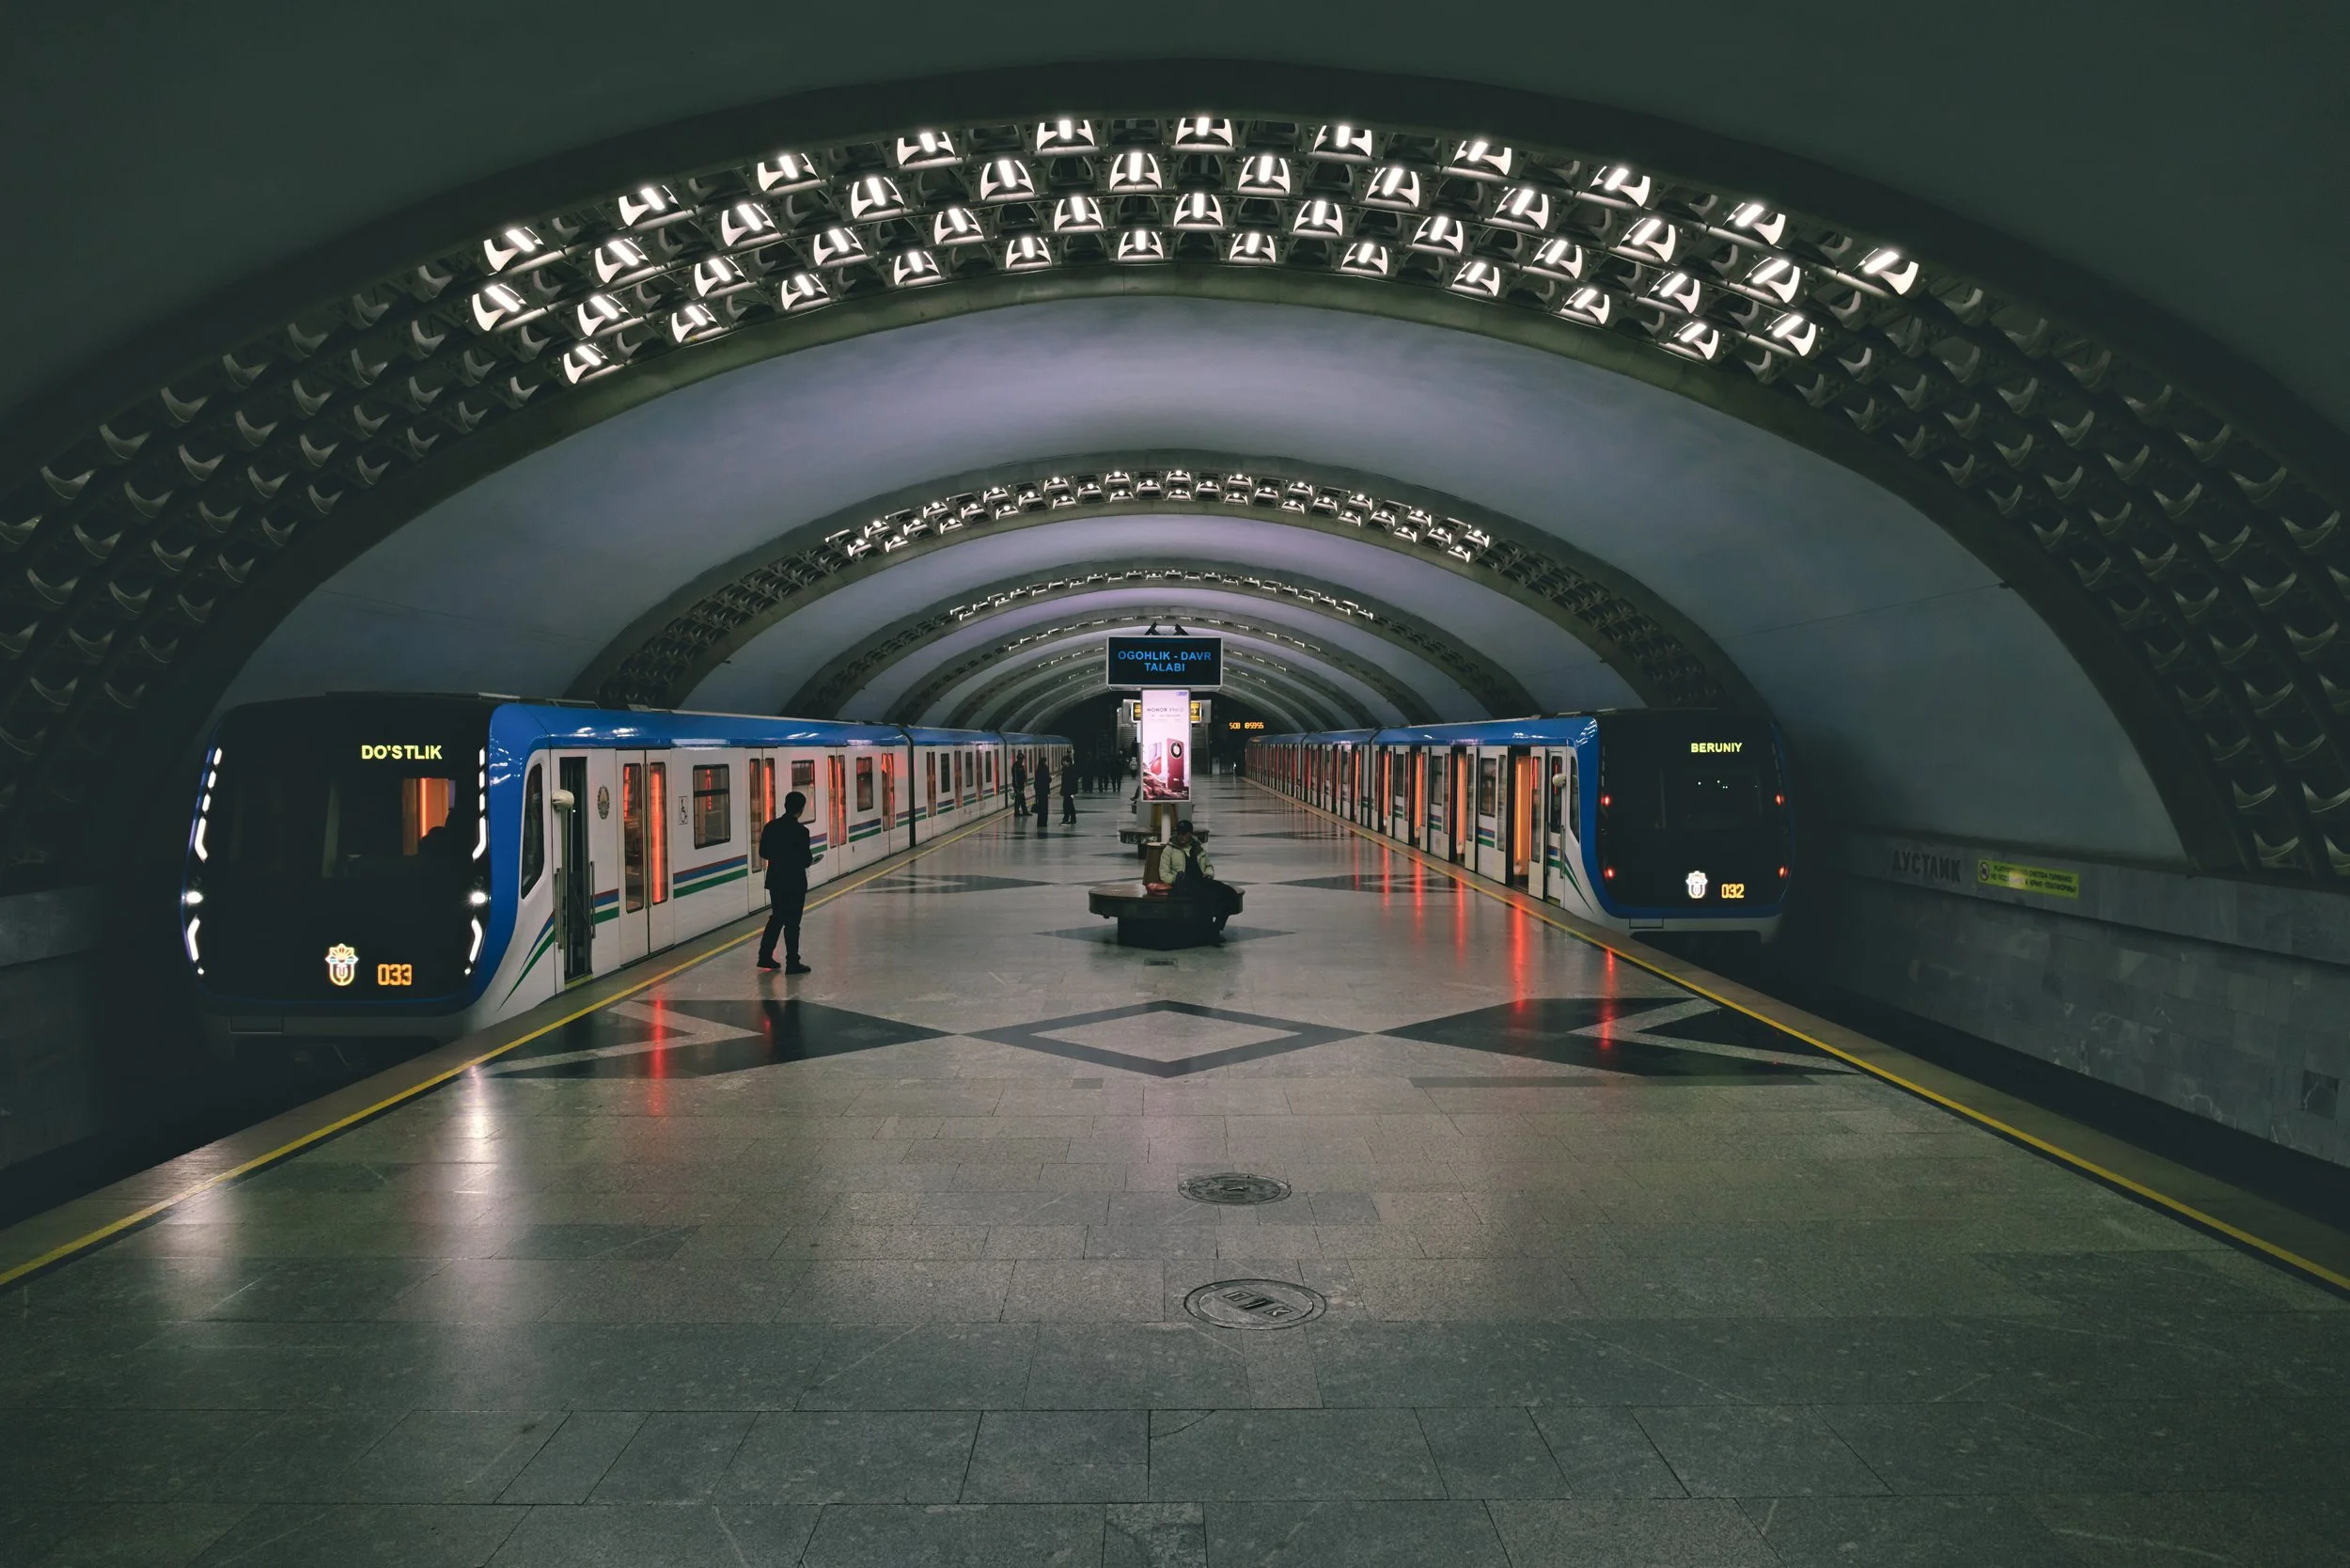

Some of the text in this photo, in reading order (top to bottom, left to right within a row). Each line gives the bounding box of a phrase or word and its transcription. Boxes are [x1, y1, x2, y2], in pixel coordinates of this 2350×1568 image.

[1118, 651, 1170, 661] OGOHLIK
[1182, 651, 1212, 661] DAVR
[1144, 663, 1185, 672] TALABI
[361, 745, 443, 760] DO'STLIK
[1690, 742, 1743, 753] BERUNIY
[1721, 883, 1745, 900] 032
[378, 964, 412, 986] 033
